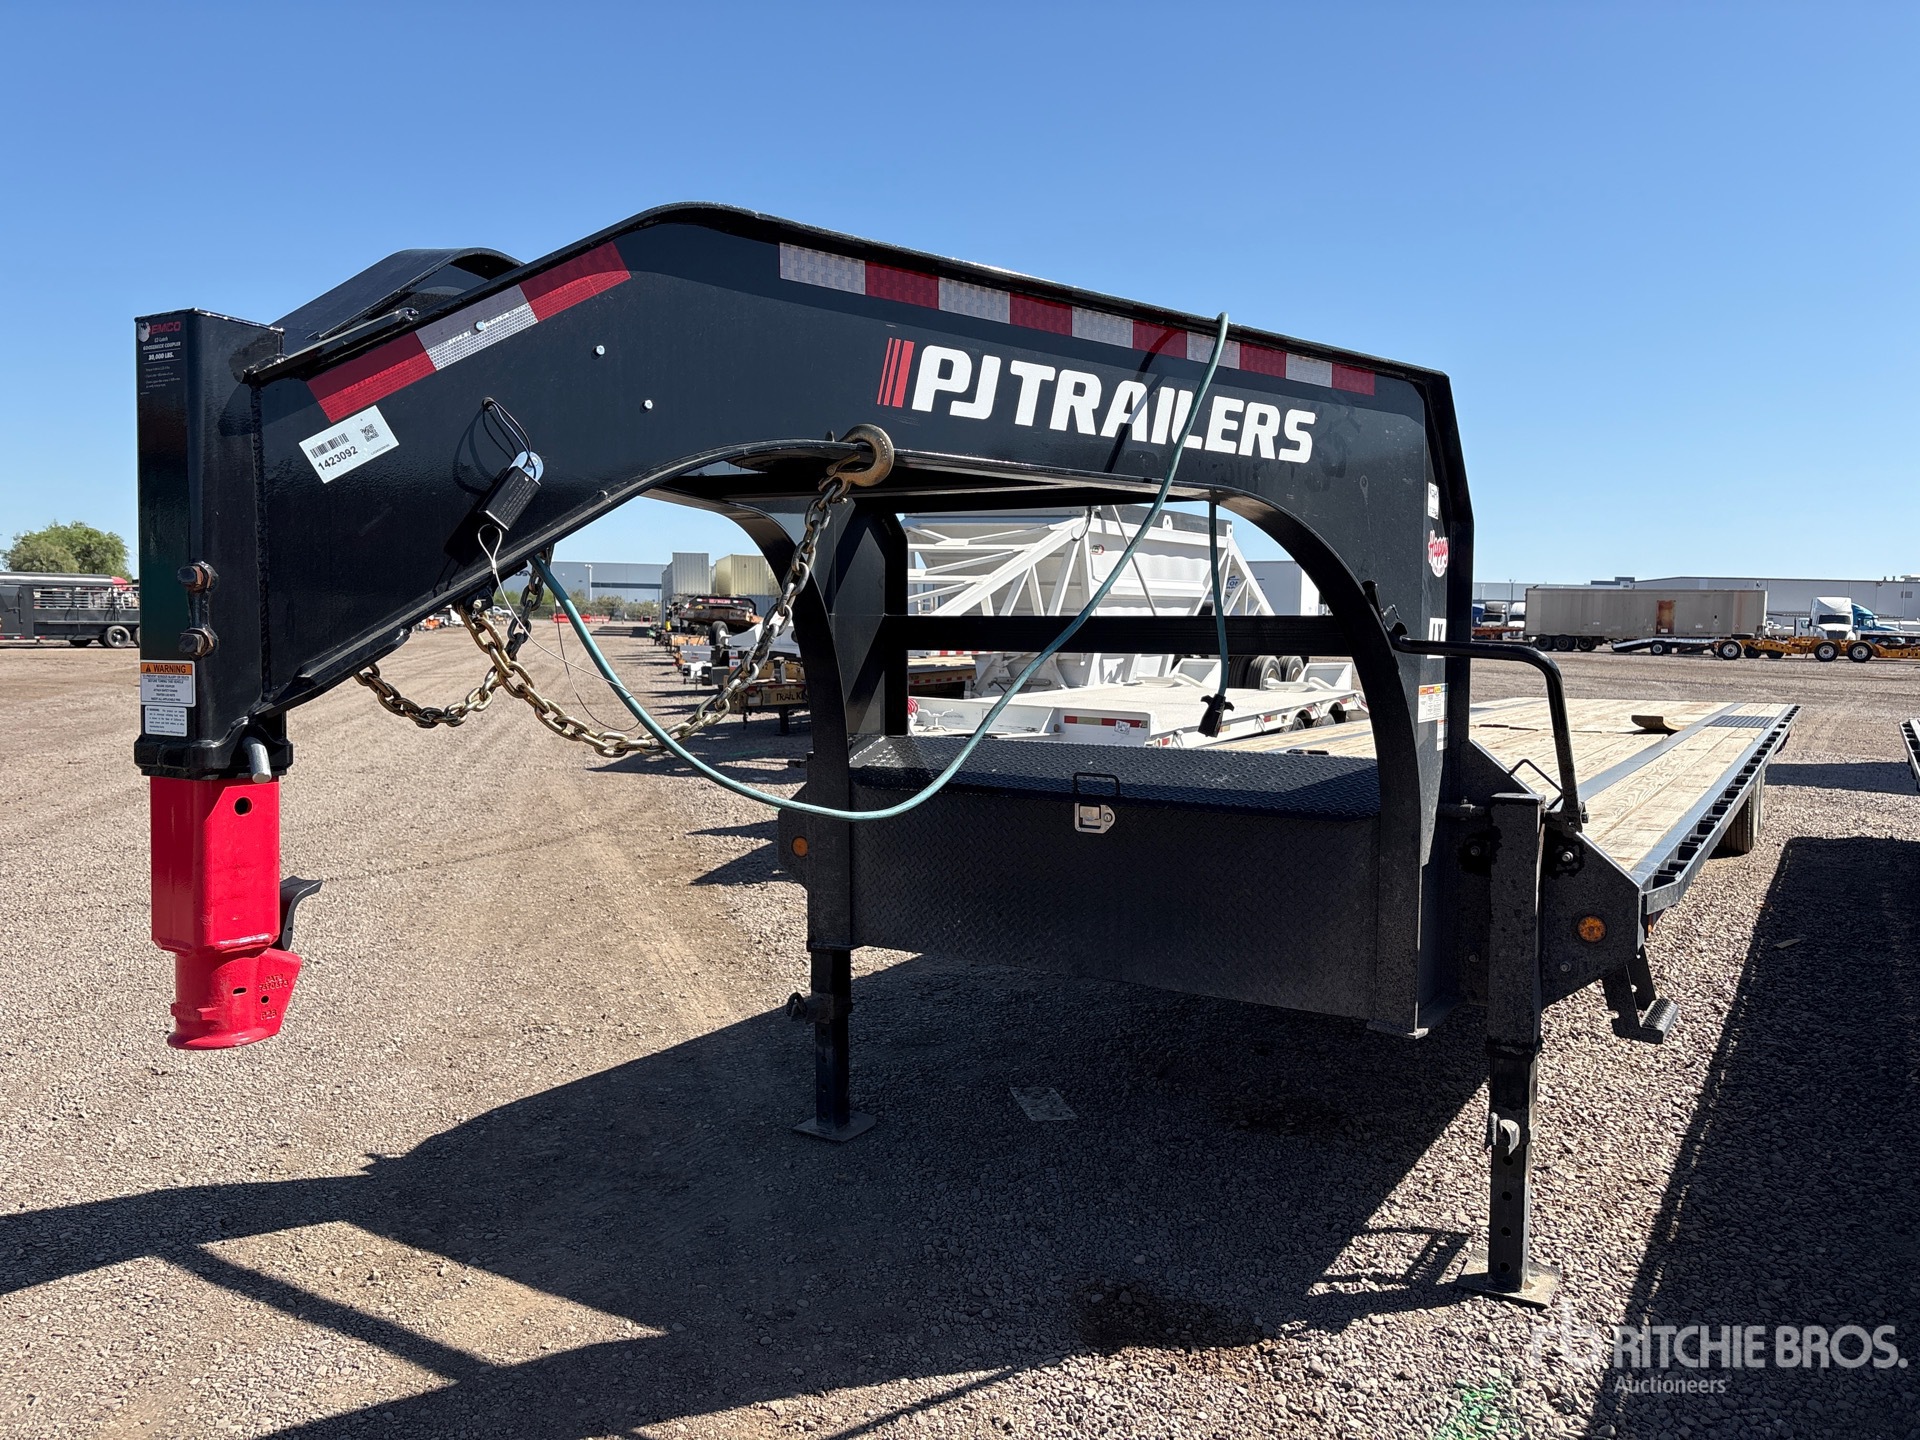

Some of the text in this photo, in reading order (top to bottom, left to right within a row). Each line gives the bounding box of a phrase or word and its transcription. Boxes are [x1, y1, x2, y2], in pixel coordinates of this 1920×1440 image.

[911, 344, 1316, 464] PJ TRAILERS
[318, 446, 358, 470] 1423092
[153, 664, 186, 674] WARNING
